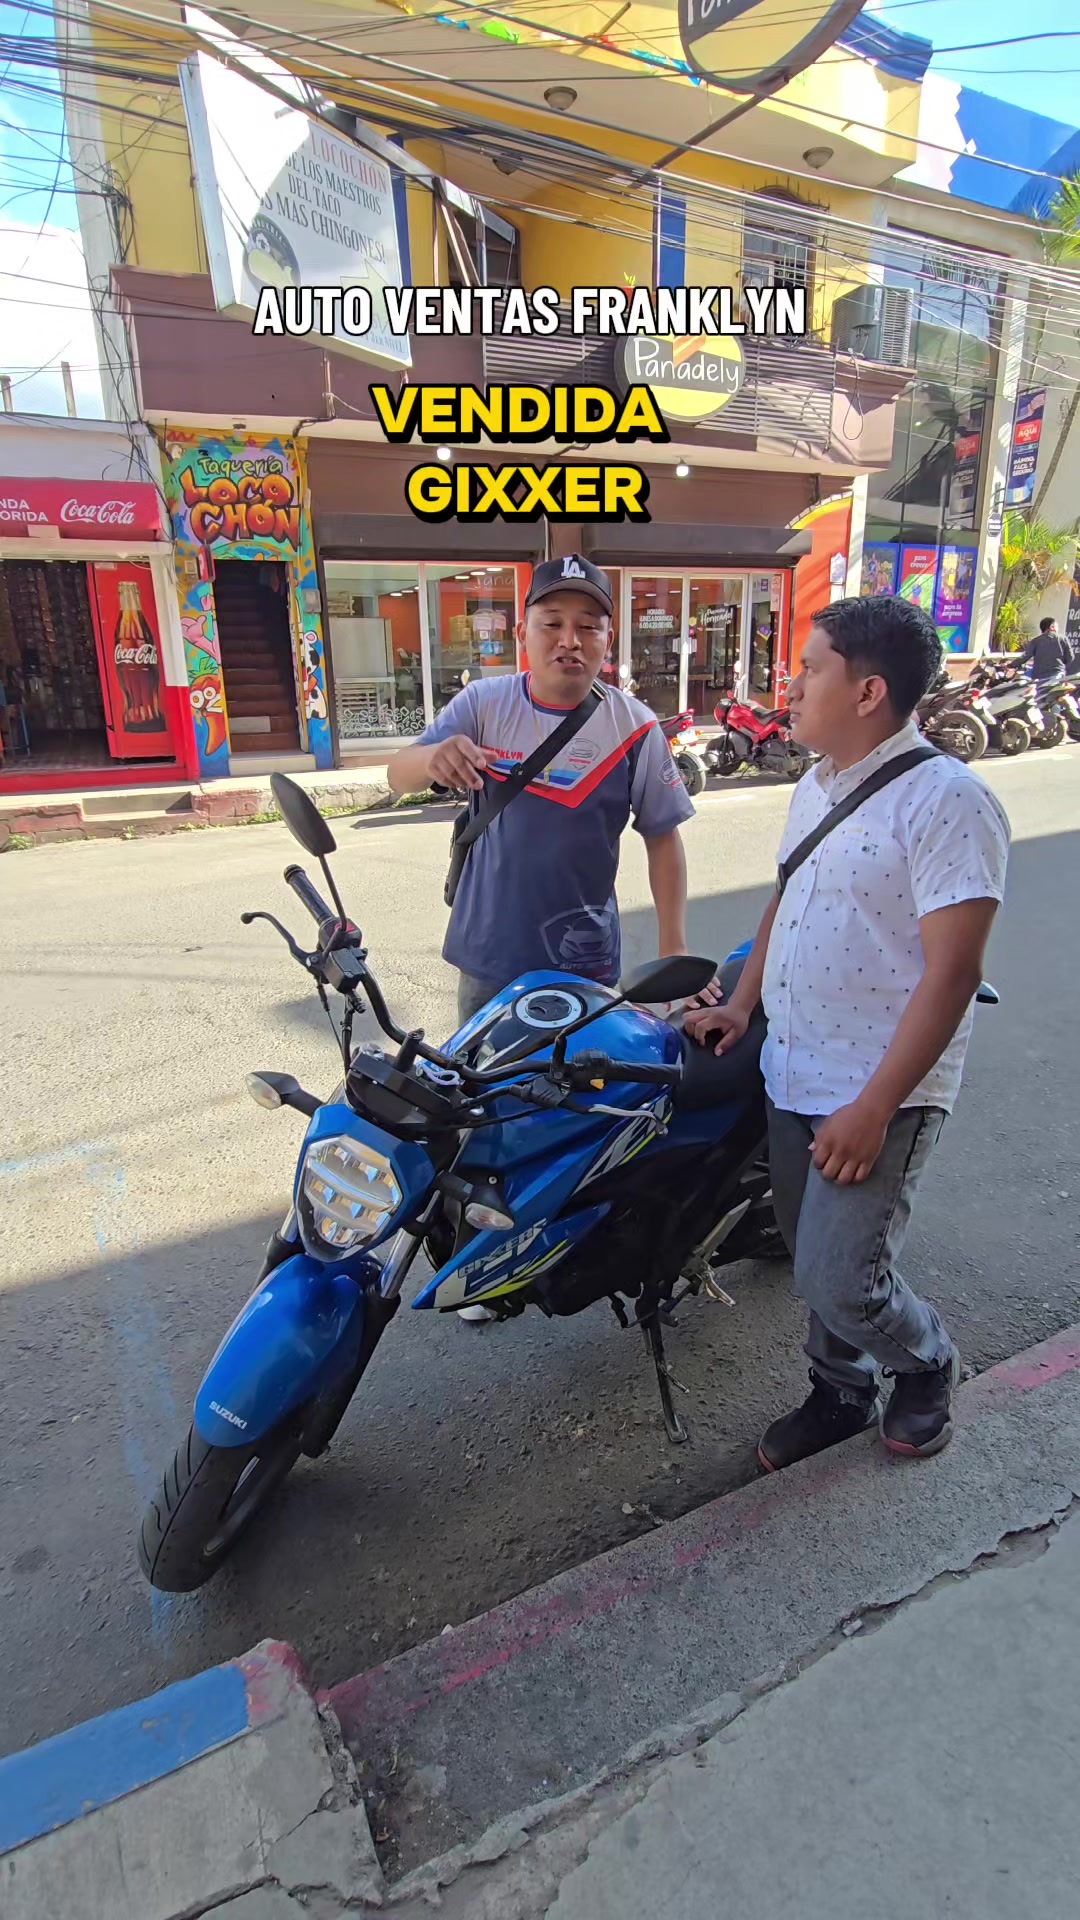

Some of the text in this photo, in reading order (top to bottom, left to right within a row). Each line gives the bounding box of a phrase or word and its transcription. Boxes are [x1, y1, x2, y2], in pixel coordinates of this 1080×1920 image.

[288, 172, 312, 203] DEL
[313, 185, 342, 218] TACO
[301, 155, 323, 185] LOS
[325, 168, 382, 216] MAESTROS
[276, 191, 309, 228] MAS
[311, 209, 386, 265] CHINGONES!
[633, 337, 739, 393] Panadely
[179, 466, 294, 508] LOCO
[198, 456, 284, 478] Taquería
[0, 510, 49, 522] ORIDA
[60, 499, 137, 524] Coca-Cola
[190, 499, 300, 552] CHÓN
[561, 556, 586, 579] LA
[115, 643, 158, 665] Coca-Cola
[457, 1225, 537, 1278] GIXXER
[208, 1401, 248, 1430] SUZUKI
